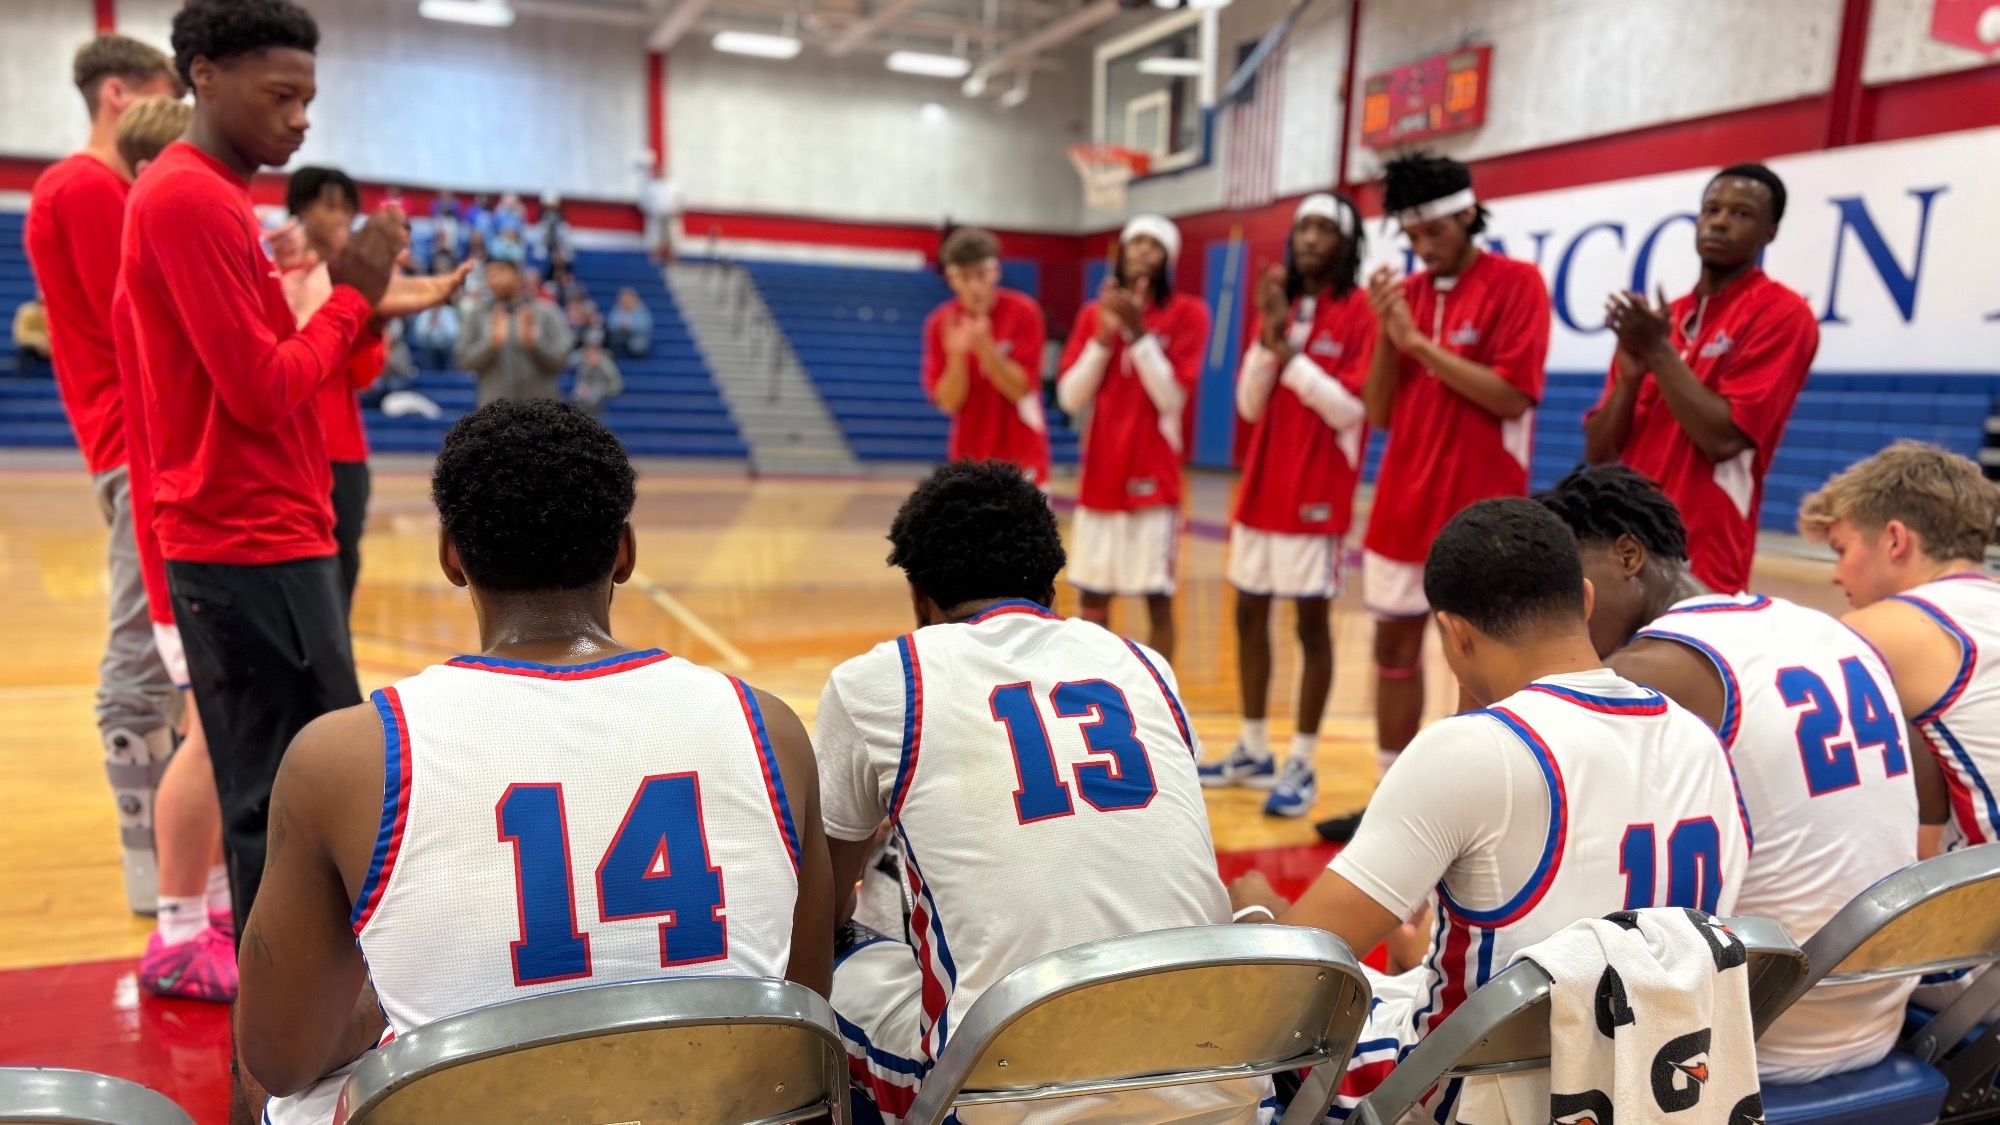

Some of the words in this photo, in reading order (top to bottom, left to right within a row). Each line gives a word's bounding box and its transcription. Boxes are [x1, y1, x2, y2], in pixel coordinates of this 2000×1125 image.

[988, 678, 1158, 825] 13
[1775, 655, 1909, 798] 24
[495, 770, 728, 987] 14
[1618, 815, 1724, 918] 10
